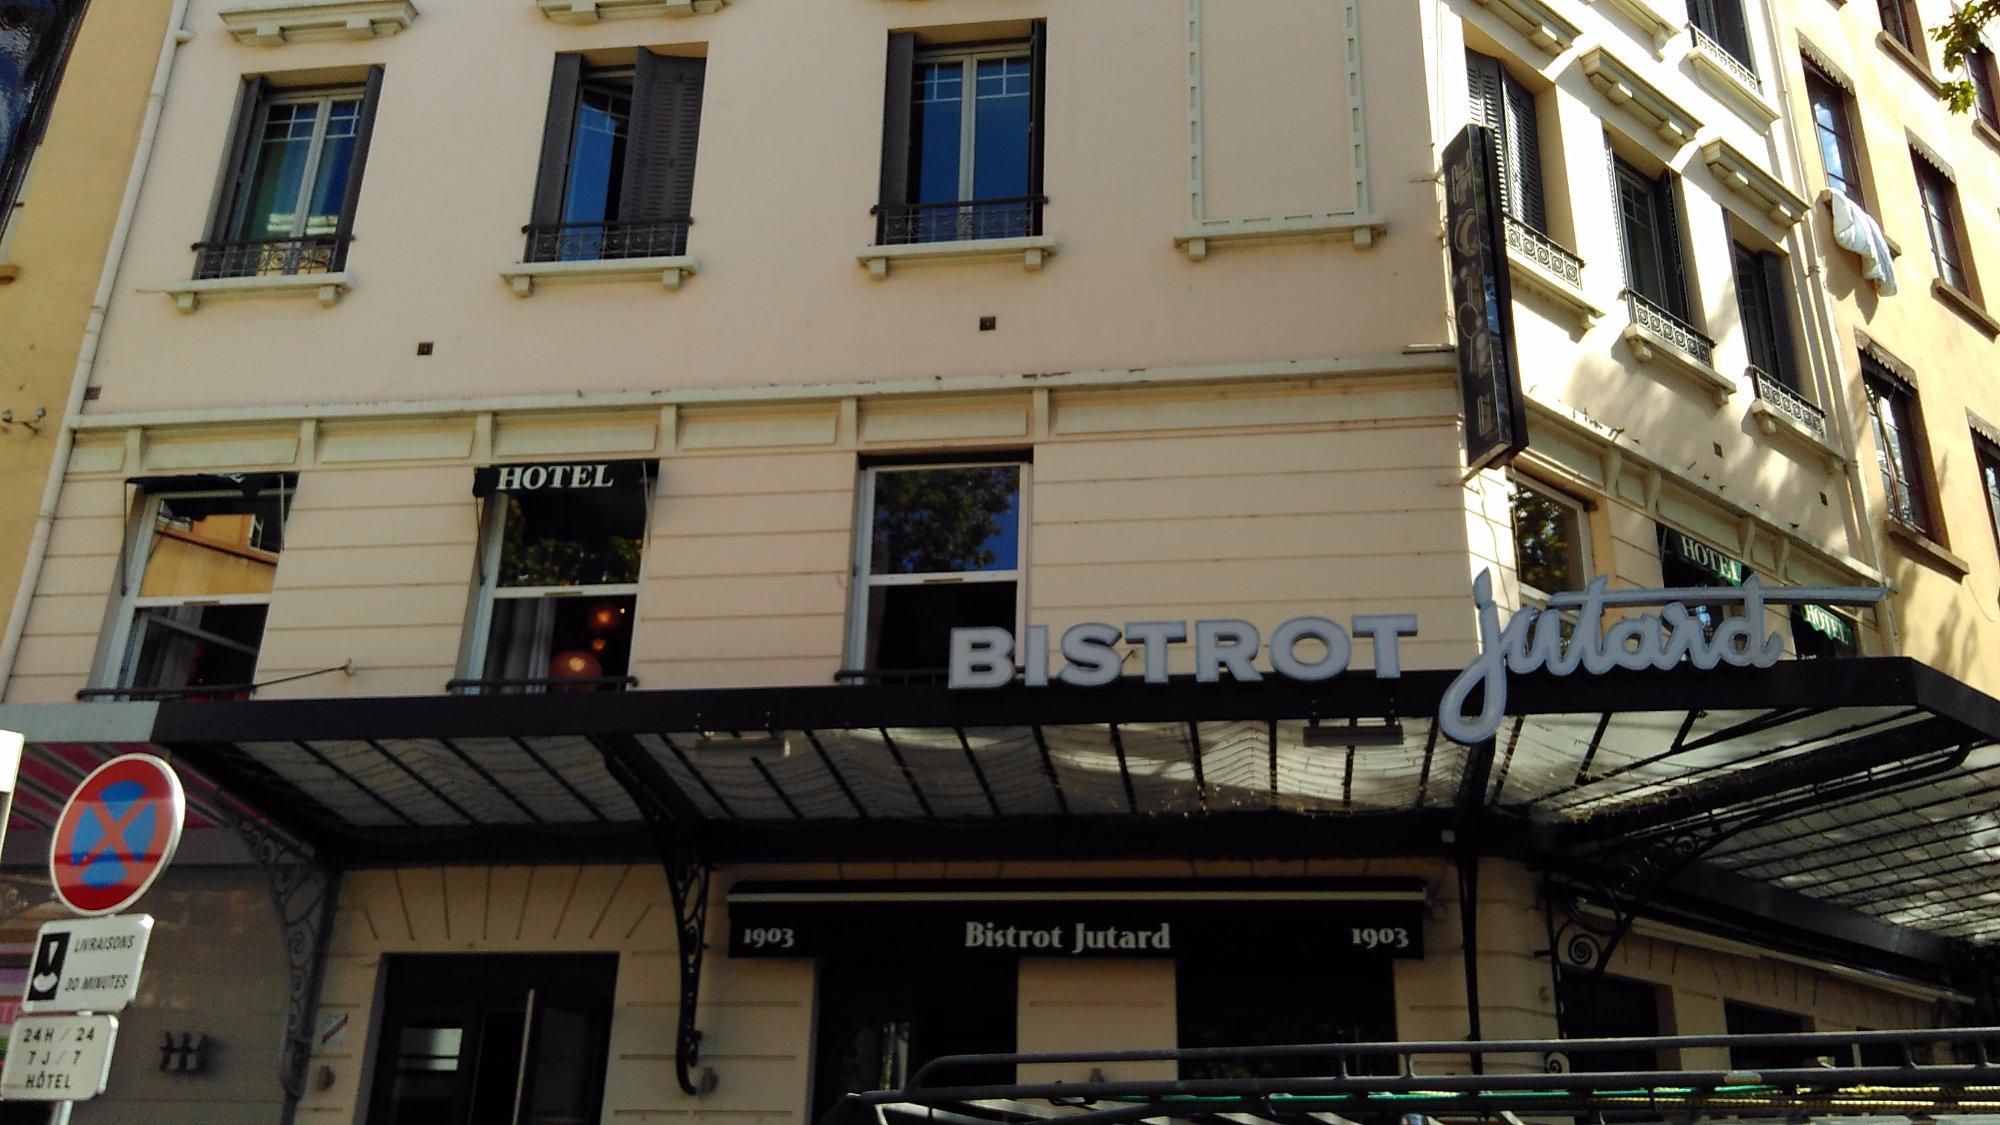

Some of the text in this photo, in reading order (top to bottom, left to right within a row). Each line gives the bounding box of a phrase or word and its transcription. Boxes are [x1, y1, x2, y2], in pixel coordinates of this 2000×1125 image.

[497, 464, 614, 491] HOTEL
[1681, 535, 1740, 583] HOTEL
[1804, 604, 1849, 646] HOTEL
[948, 614, 1418, 690] BISTROT
[74, 935, 135, 953] LIVRAISONS
[742, 921, 1409, 954] 1903 Bistrot Jutard 1903
[65, 974, 128, 991] 30 MINUTES
